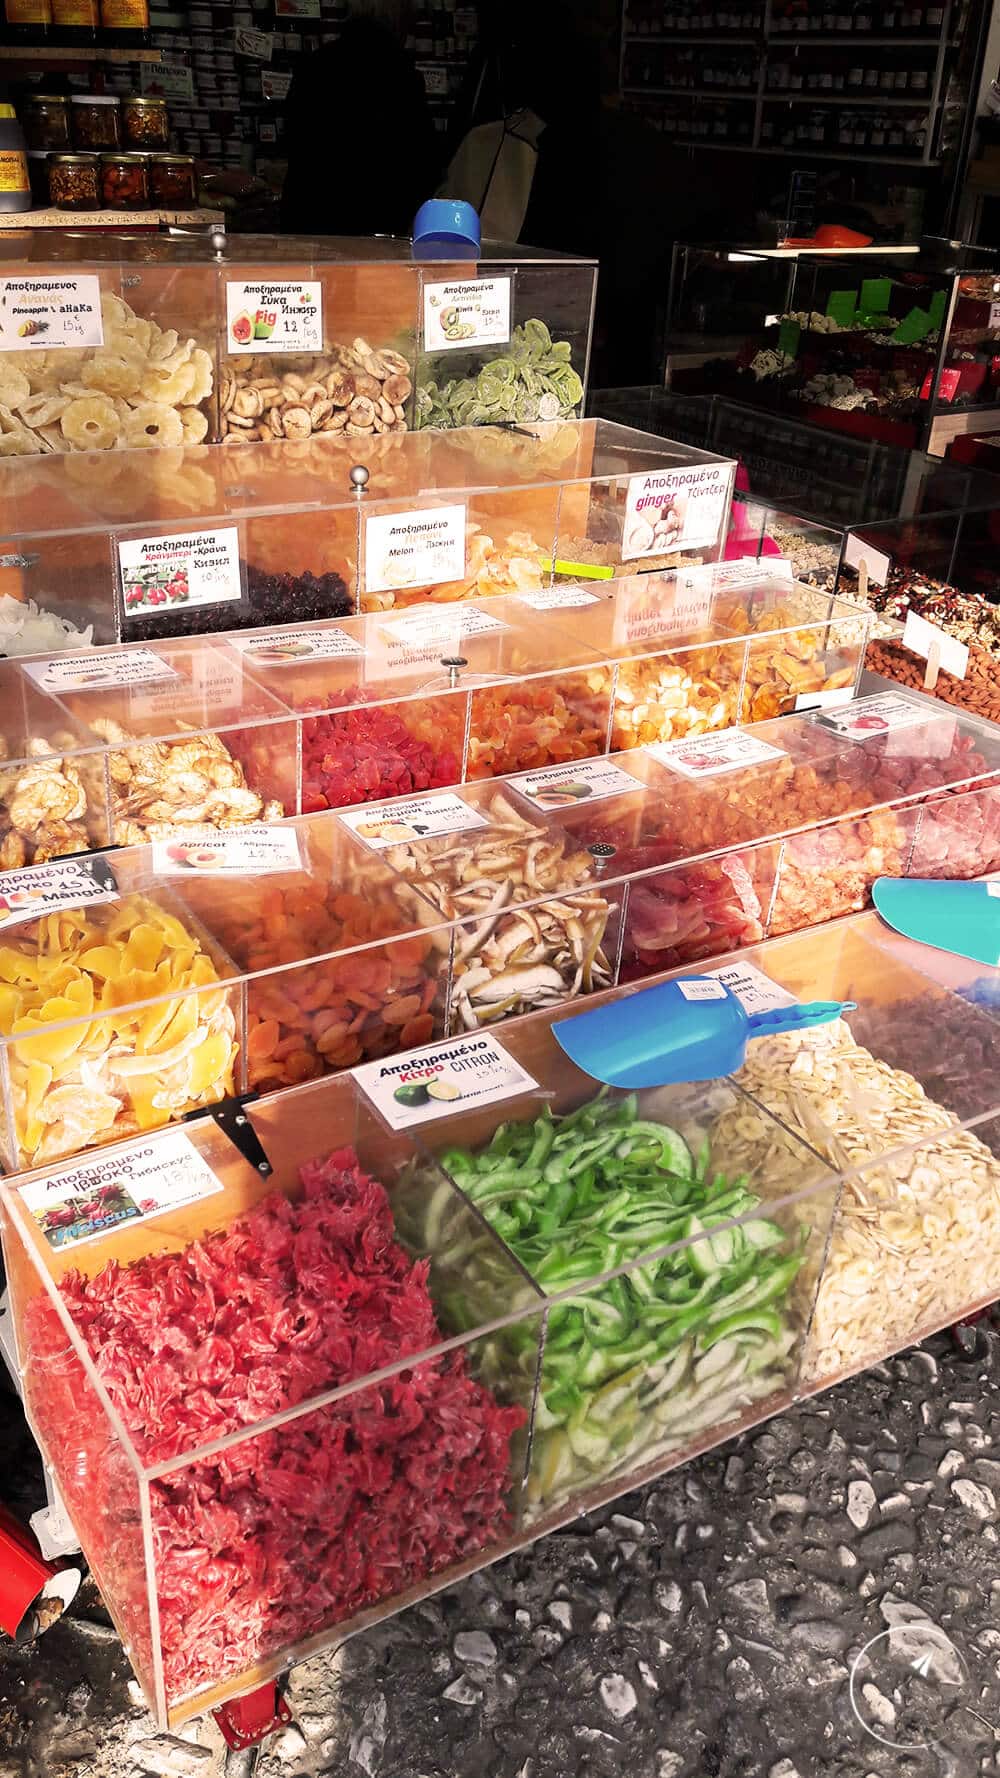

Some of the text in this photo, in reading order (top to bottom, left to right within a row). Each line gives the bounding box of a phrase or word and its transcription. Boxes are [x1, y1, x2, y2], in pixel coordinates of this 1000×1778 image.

[244, 285, 302, 295] Αποξηραμένα
[443, 283, 494, 295] Αποξηραμένα
[12, 306, 48, 315] Pineapple
[255, 309, 277, 327] Fig
[281, 305, 317, 316] Инжир
[284, 320, 298, 333] 12
[644, 469, 719, 490] Αποξηραμένο
[687, 484, 726, 499] Τζίντζερ
[636, 492, 678, 512] ginger
[389, 521, 448, 536] Αποξηραμένο
[141, 536, 216, 554] Αποξηραμένα
[388, 547, 414, 557] Melon
[179, 841, 227, 850] Apricot
[0, 866, 77, 887] ηραμένο
[42, 888, 104, 902] Mango
[379, 1041, 488, 1078] Αποξηραμένο
[399, 1051, 500, 1083] Κίτρο CITRON
